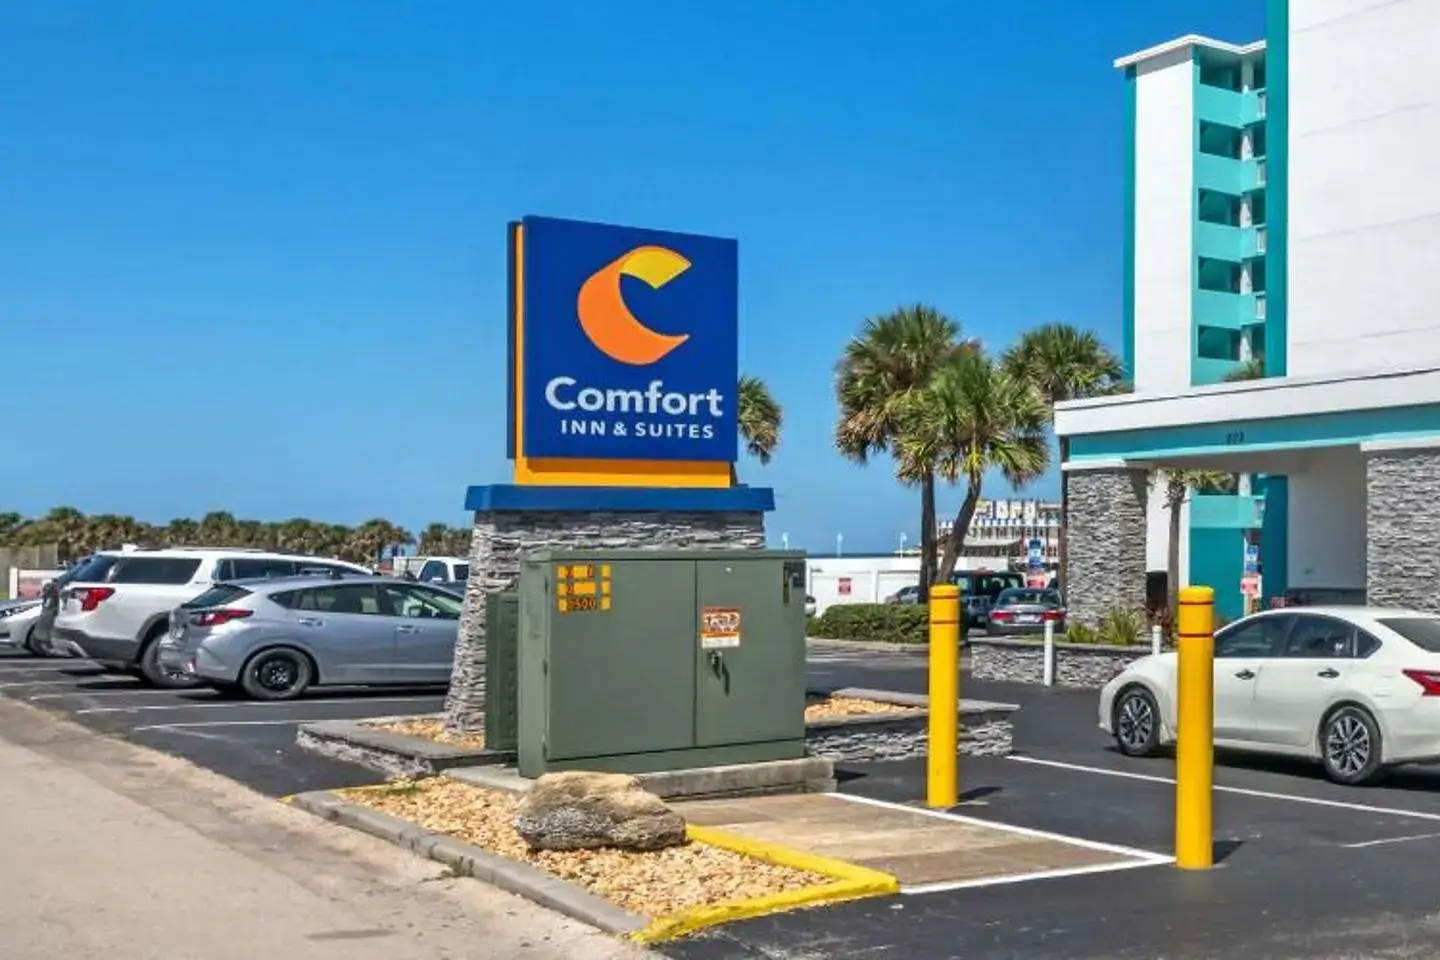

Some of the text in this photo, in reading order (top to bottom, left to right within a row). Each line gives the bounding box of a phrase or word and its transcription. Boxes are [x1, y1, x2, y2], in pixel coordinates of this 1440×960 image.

[545, 376, 723, 417] Comfort
[561, 419, 714, 439] INN & SUITES
